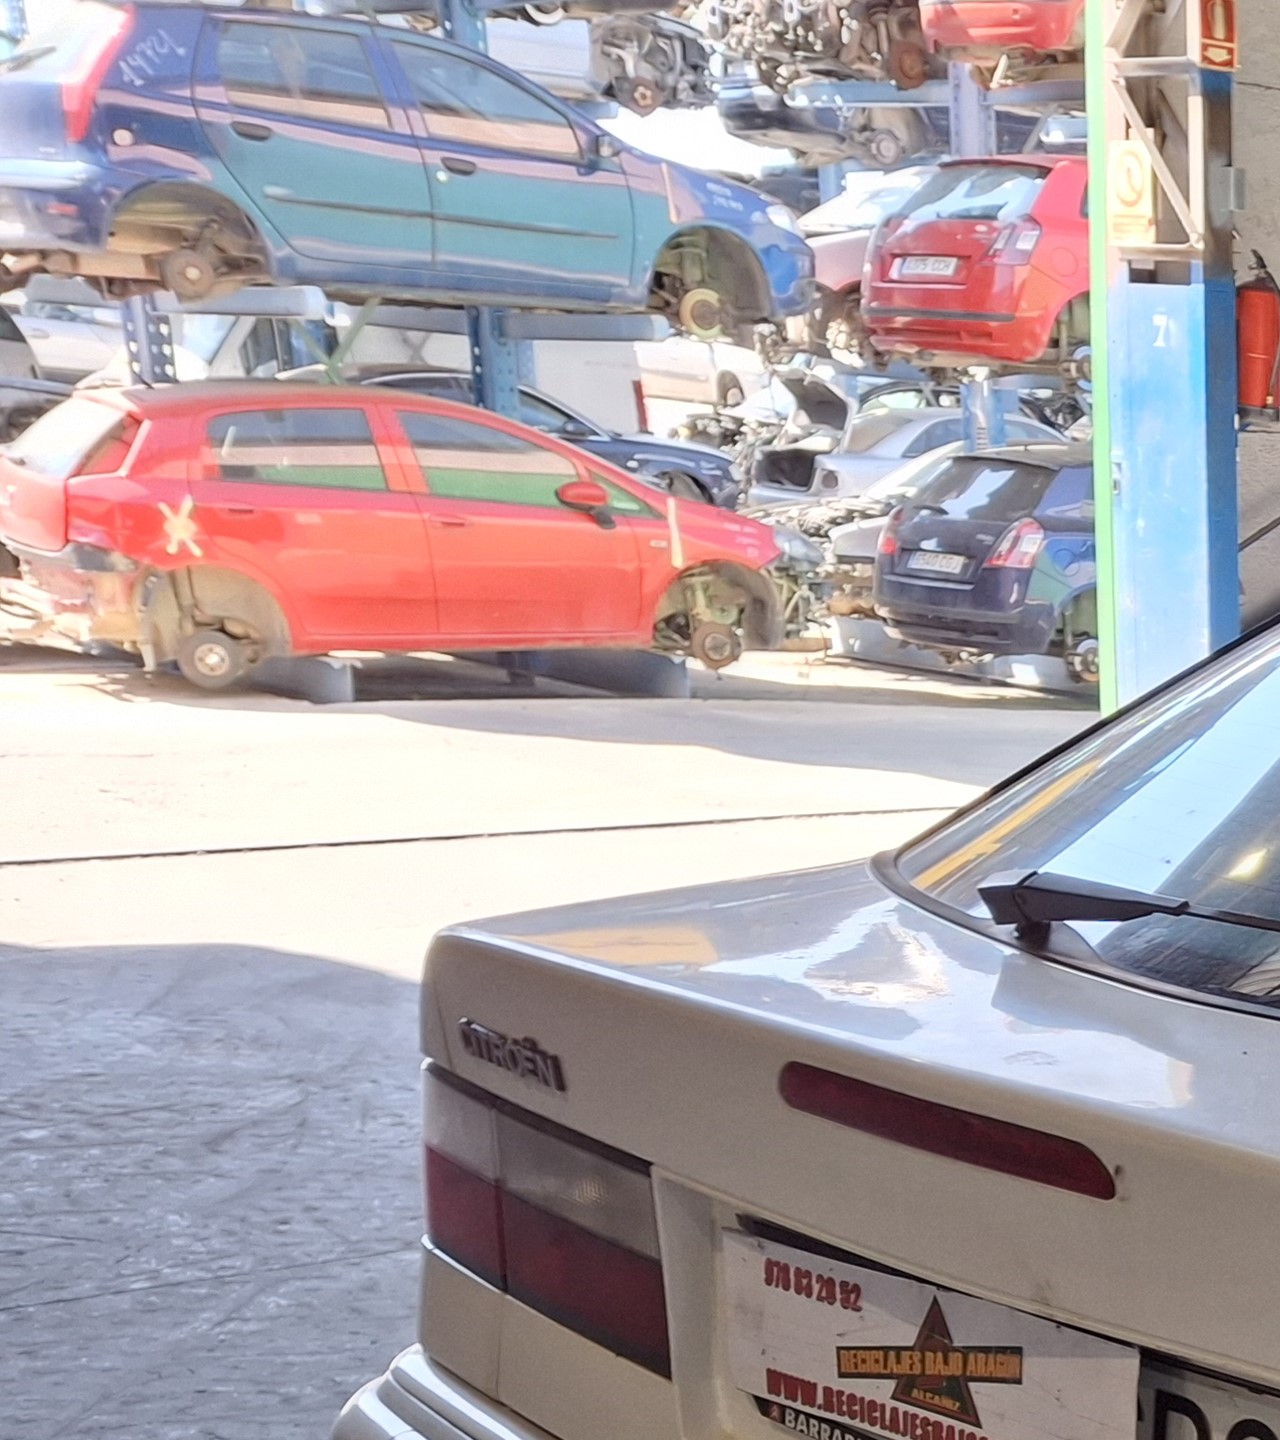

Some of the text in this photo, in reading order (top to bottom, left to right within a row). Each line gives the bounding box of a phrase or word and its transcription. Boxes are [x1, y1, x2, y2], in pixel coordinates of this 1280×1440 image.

[764, 1256, 792, 1292] 978
[839, 1280, 863, 1313] 52
[839, 1349, 922, 1375] RECICLAJES
[924, 1351, 964, 1377] BAJO
